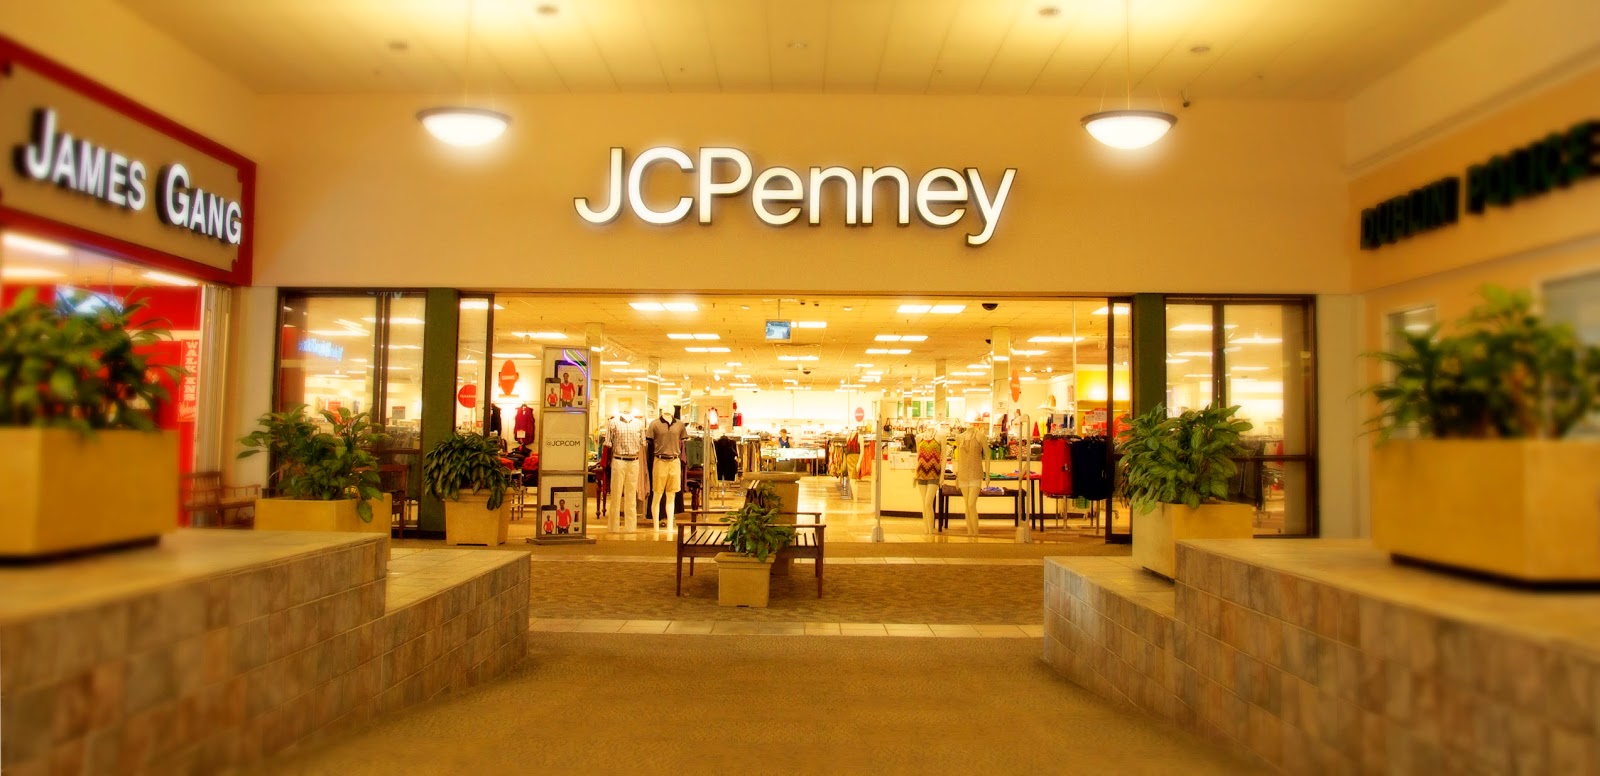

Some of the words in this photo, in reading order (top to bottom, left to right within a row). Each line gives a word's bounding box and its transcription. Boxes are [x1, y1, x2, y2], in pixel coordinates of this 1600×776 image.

[22, 107, 148, 212] JAMES
[160, 162, 243, 246] GANG
[573, 146, 1018, 247] JCPenney
